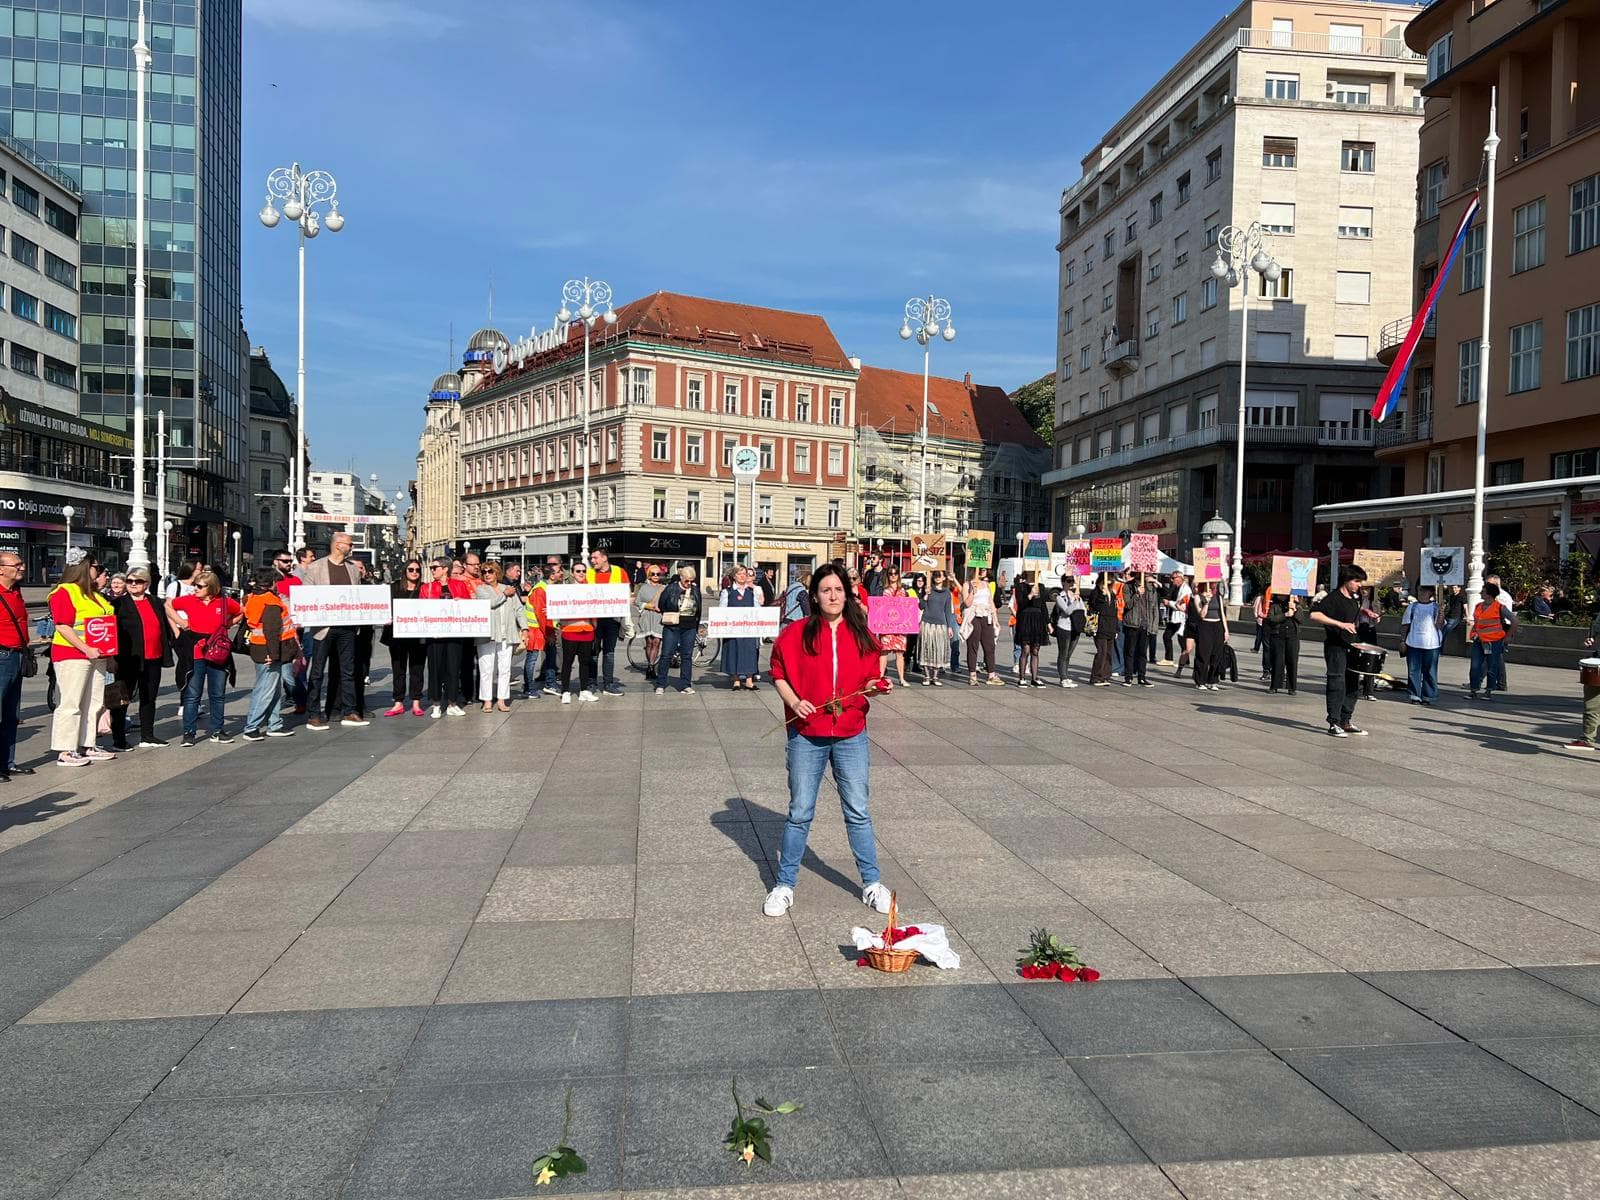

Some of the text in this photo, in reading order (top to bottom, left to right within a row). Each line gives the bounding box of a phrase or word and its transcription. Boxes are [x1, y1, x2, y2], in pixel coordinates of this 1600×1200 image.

[19, 407, 47, 427] UŽIVANJE
[52, 418, 70, 432] RITMU
[18, 498, 38, 514] bolja
[649, 537, 681, 549] ZAKS
[293, 603, 318, 612] Zagreb
